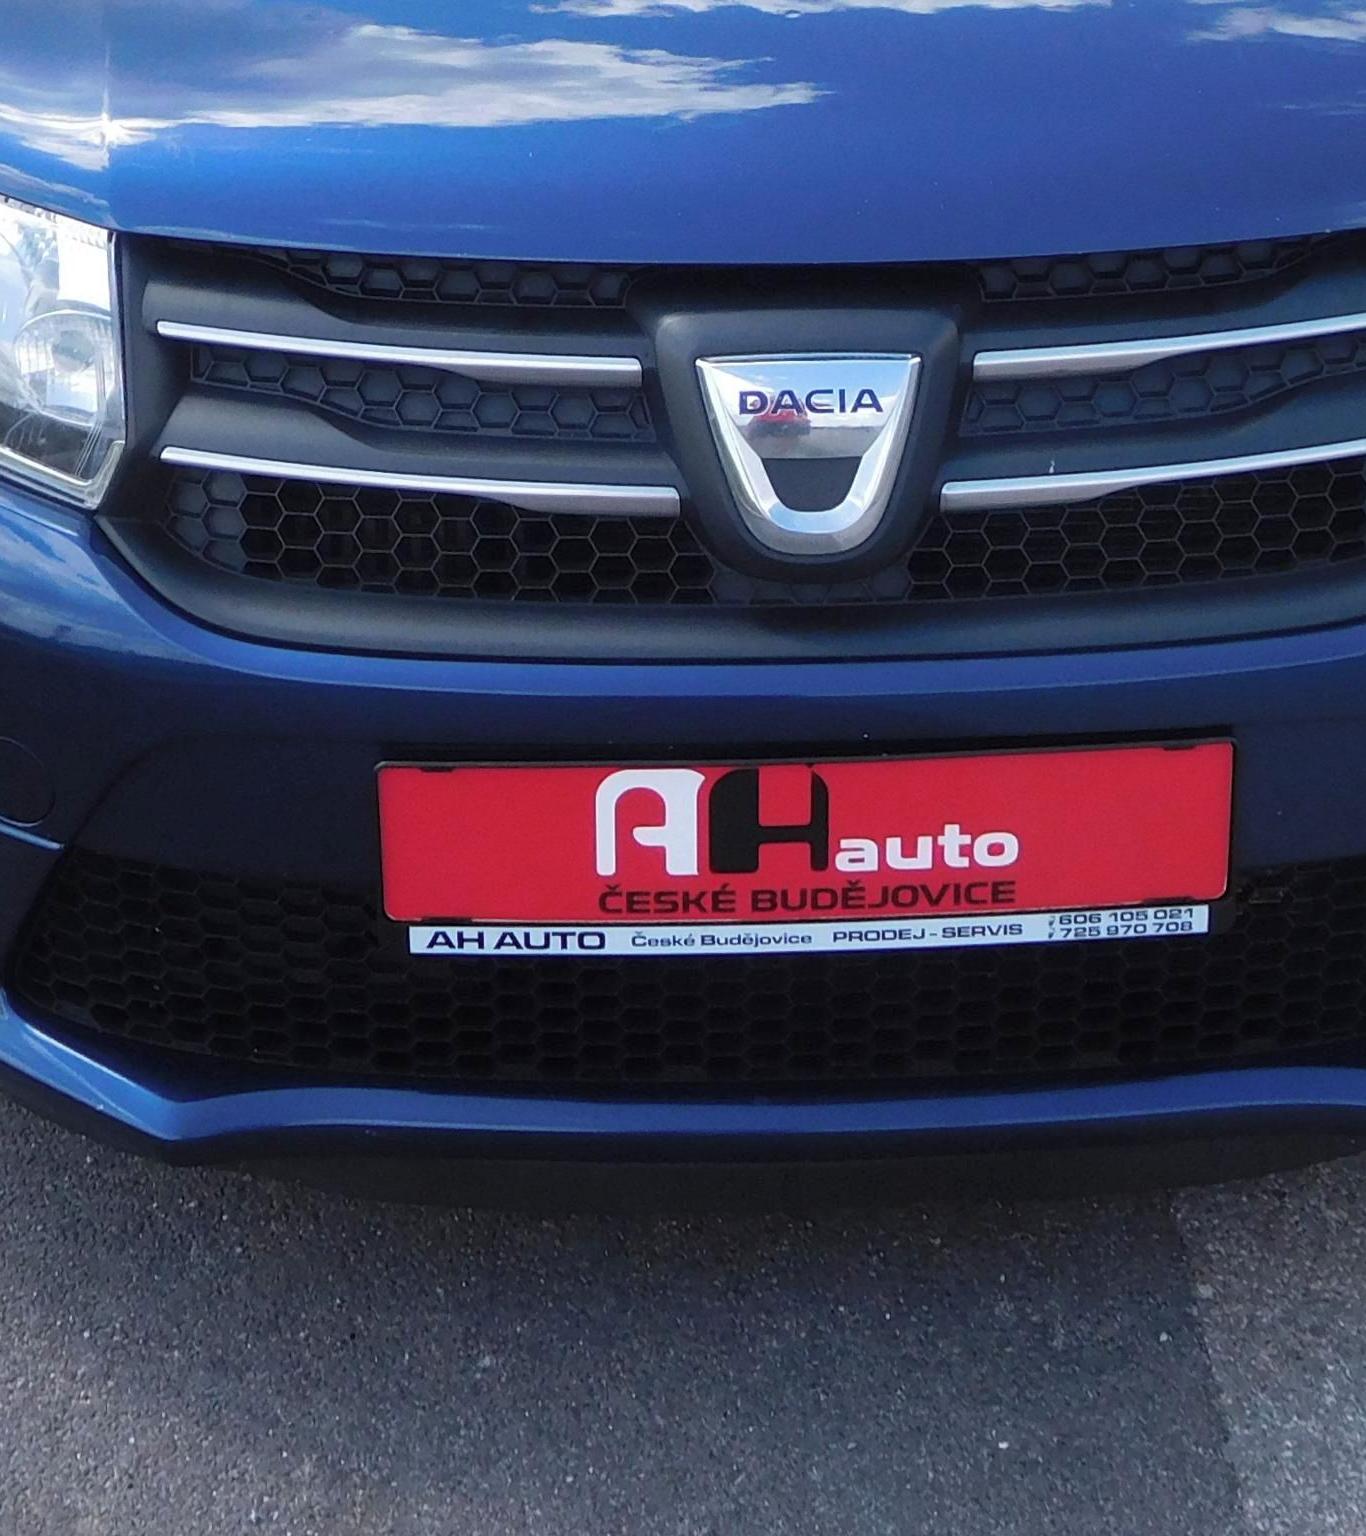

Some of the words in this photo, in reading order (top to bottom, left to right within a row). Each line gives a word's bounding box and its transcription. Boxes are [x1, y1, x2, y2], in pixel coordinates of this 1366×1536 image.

[738, 388, 884, 415] DACIA
[598, 884, 736, 914] ČESKÉ
[751, 880, 1016, 912] BUDĚJOVICE
[1059, 913, 1102, 926] 606
[1109, 910, 1148, 923] 105
[1153, 907, 1194, 921] 021
[1060, 926, 1101, 938] 725
[1106, 923, 1147, 937] 970
[1152, 921, 1193, 934] 708
[426, 931, 485, 950] AH
[493, 931, 606, 950] AUTO
[631, 931, 695, 947] České
[700, 932, 813, 948] Budějovice
[833, 928, 925, 942] PRODEJ
[942, 923, 1023, 939] SERVIS
